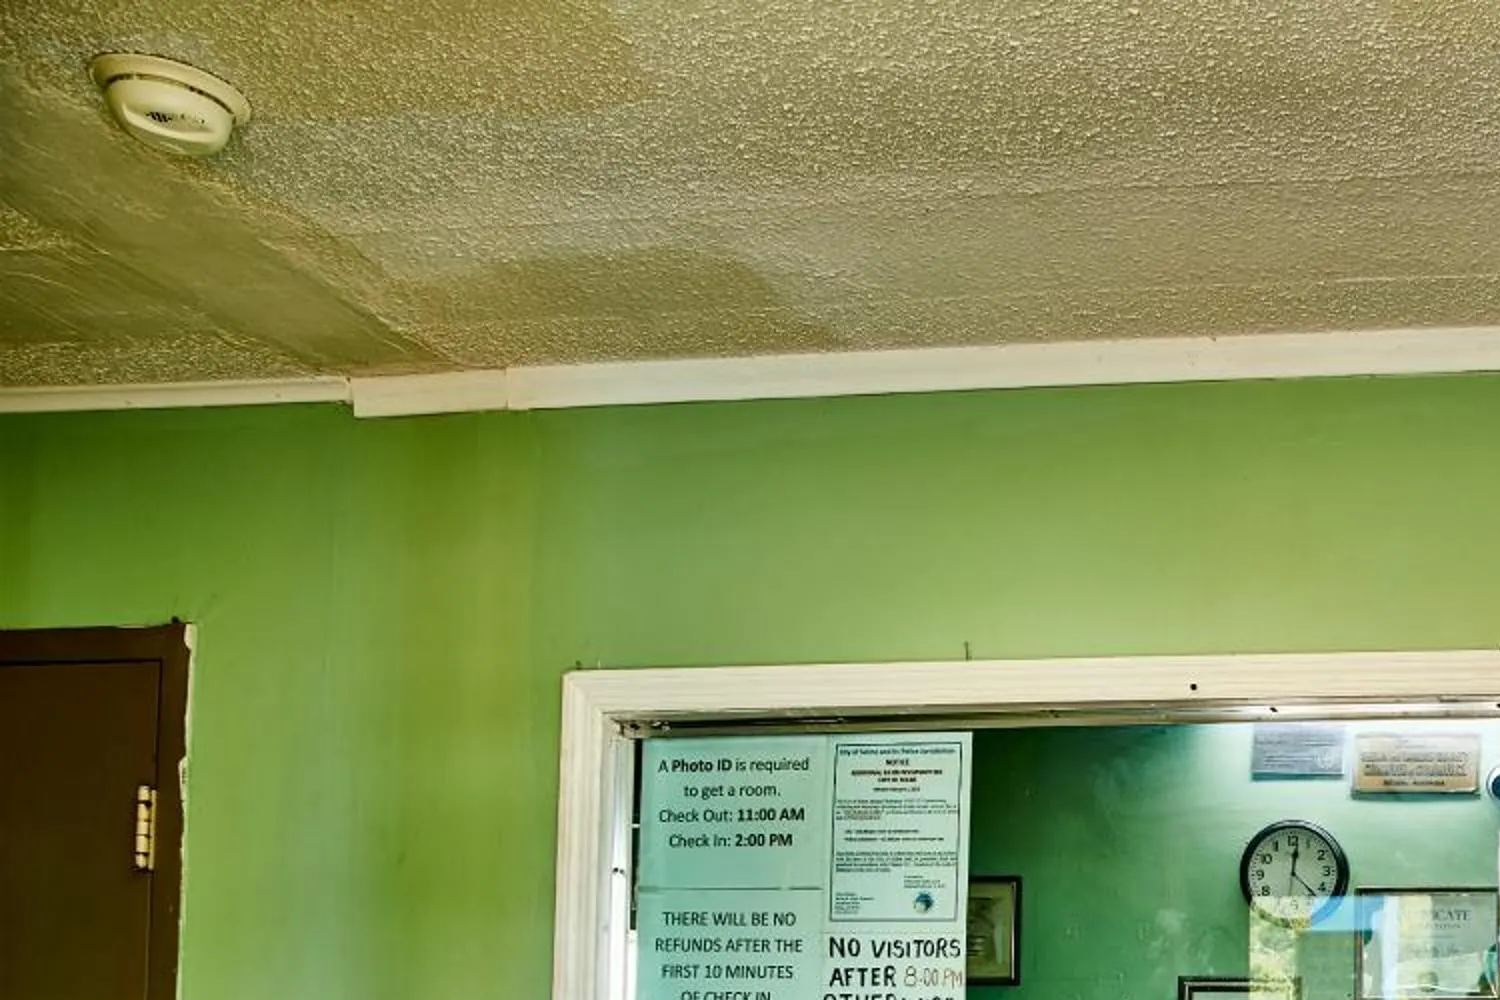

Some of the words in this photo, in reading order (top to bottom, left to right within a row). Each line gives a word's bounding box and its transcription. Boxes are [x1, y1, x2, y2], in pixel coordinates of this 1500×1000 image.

[658, 760, 669, 772] A
[672, 759, 713, 772] Photo
[718, 759, 732, 771] ID
[736, 758, 747, 771] is
[750, 757, 810, 774] required
[684, 785, 699, 797] to
[701, 785, 724, 800] get
[728, 787, 735, 797] a
[739, 785, 781, 797] room.
[659, 809, 699, 822] Check
[703, 809, 733, 822] Out:
[738, 808, 777, 821] 11:00
[779, 808, 805, 821] AM
[669, 834, 708, 847] Check
[713, 834, 731, 846] In:
[735, 833, 765, 847] 2:00
[769, 833, 793, 846] PM
[662, 911, 709, 927] THERE
[713, 911, 746, 927] WILL
[751, 911, 769, 927] BE
[773, 911, 797, 927] NO
[655, 938, 722, 953] REFUNDS
[725, 938, 771, 953] AFTER
[774, 939, 803, 953] THE
[829, 937, 861, 958] NO
[871, 937, 961, 959] VISITORS
[662, 964, 700, 979] FIRST
[705, 965, 722, 979] 10
[725, 965, 793, 979] MINUTES
[829, 965, 897, 987] AFTER
[943, 969, 963, 989] PM
